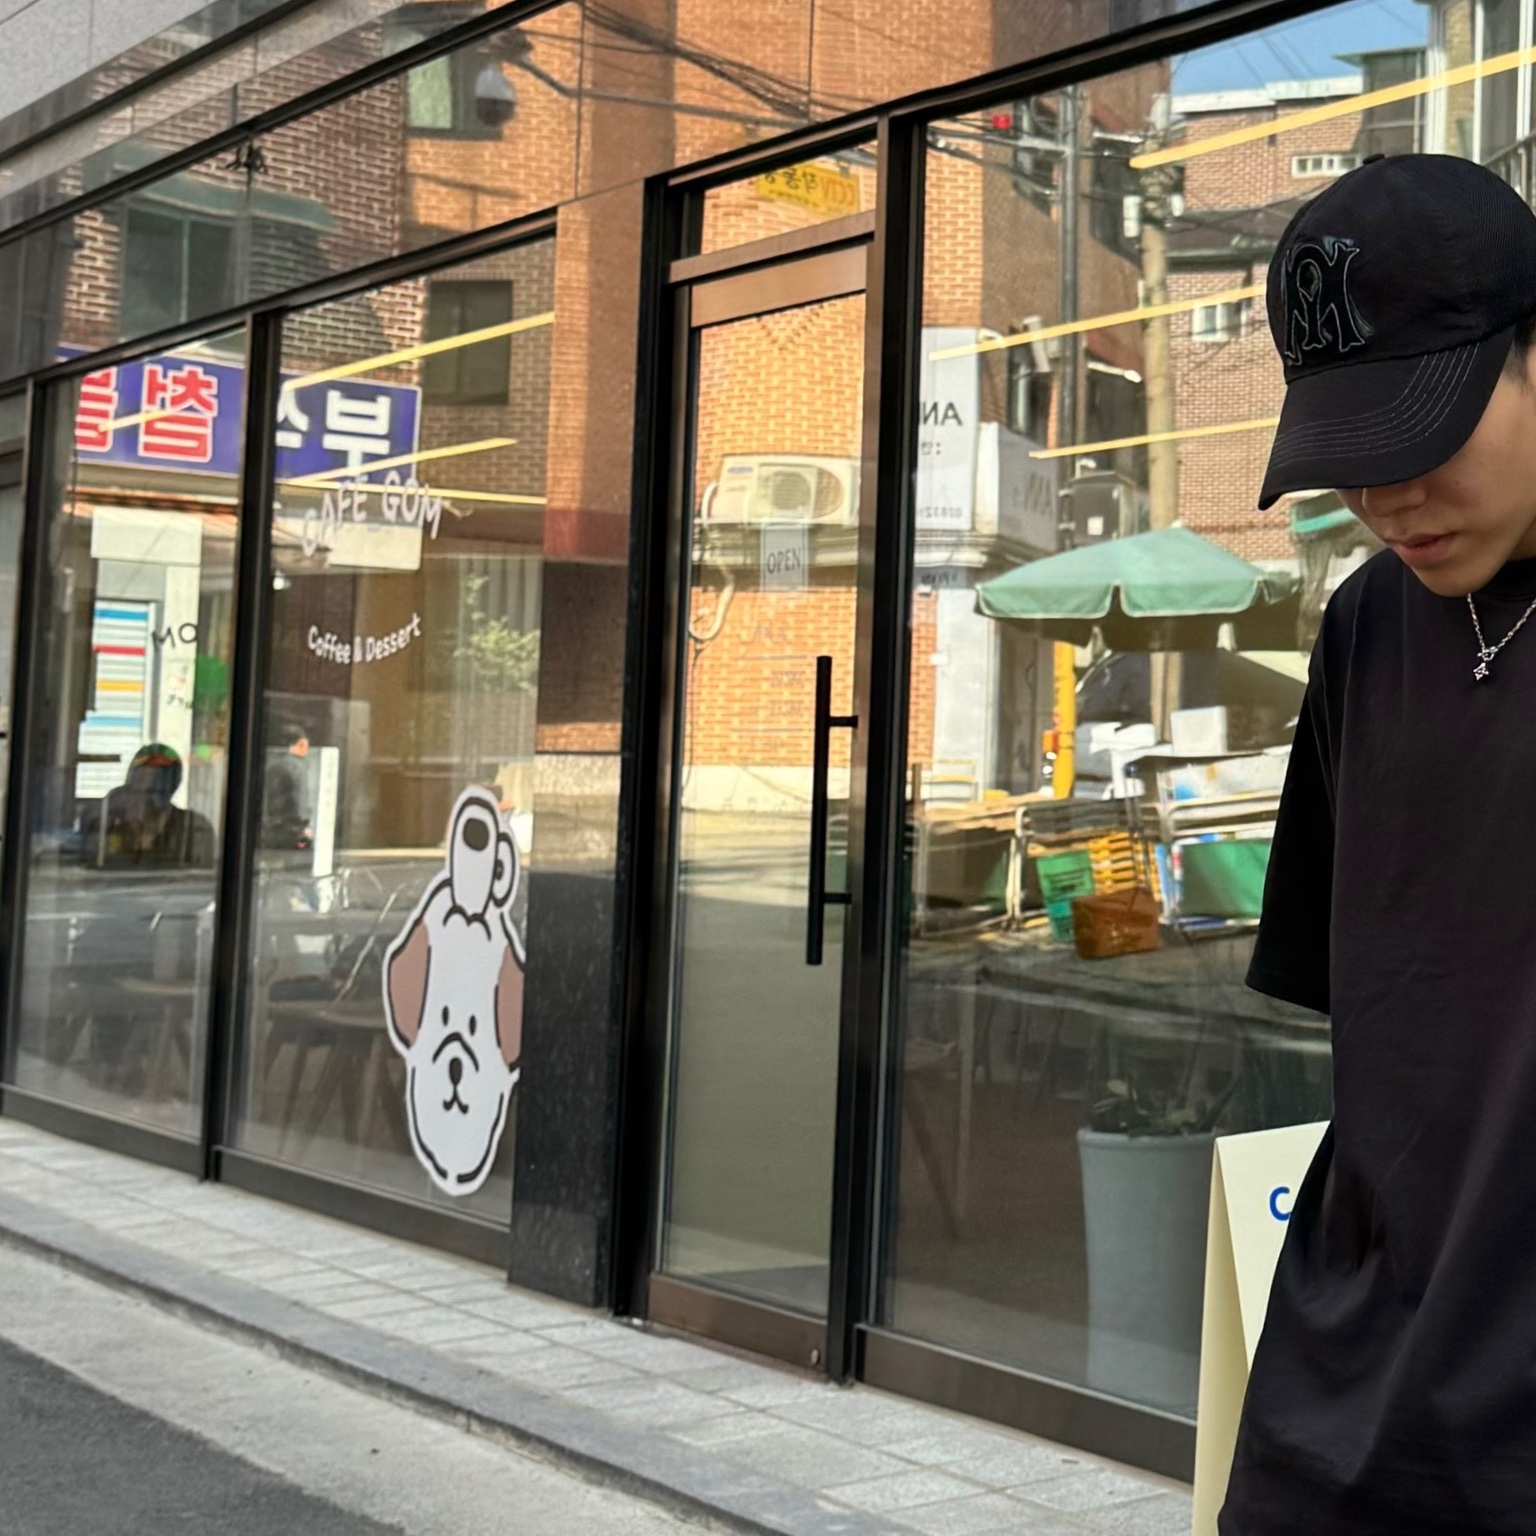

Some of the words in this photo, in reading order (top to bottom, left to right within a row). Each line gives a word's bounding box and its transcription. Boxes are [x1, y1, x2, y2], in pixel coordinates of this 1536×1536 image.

[302, 474, 369, 557] CAFE
[381, 470, 442, 540] GOM
[766, 549, 802, 575] OPEN
[308, 624, 351, 664] Coffee
[353, 636, 362, 664] &
[365, 612, 421, 662] Dessert
